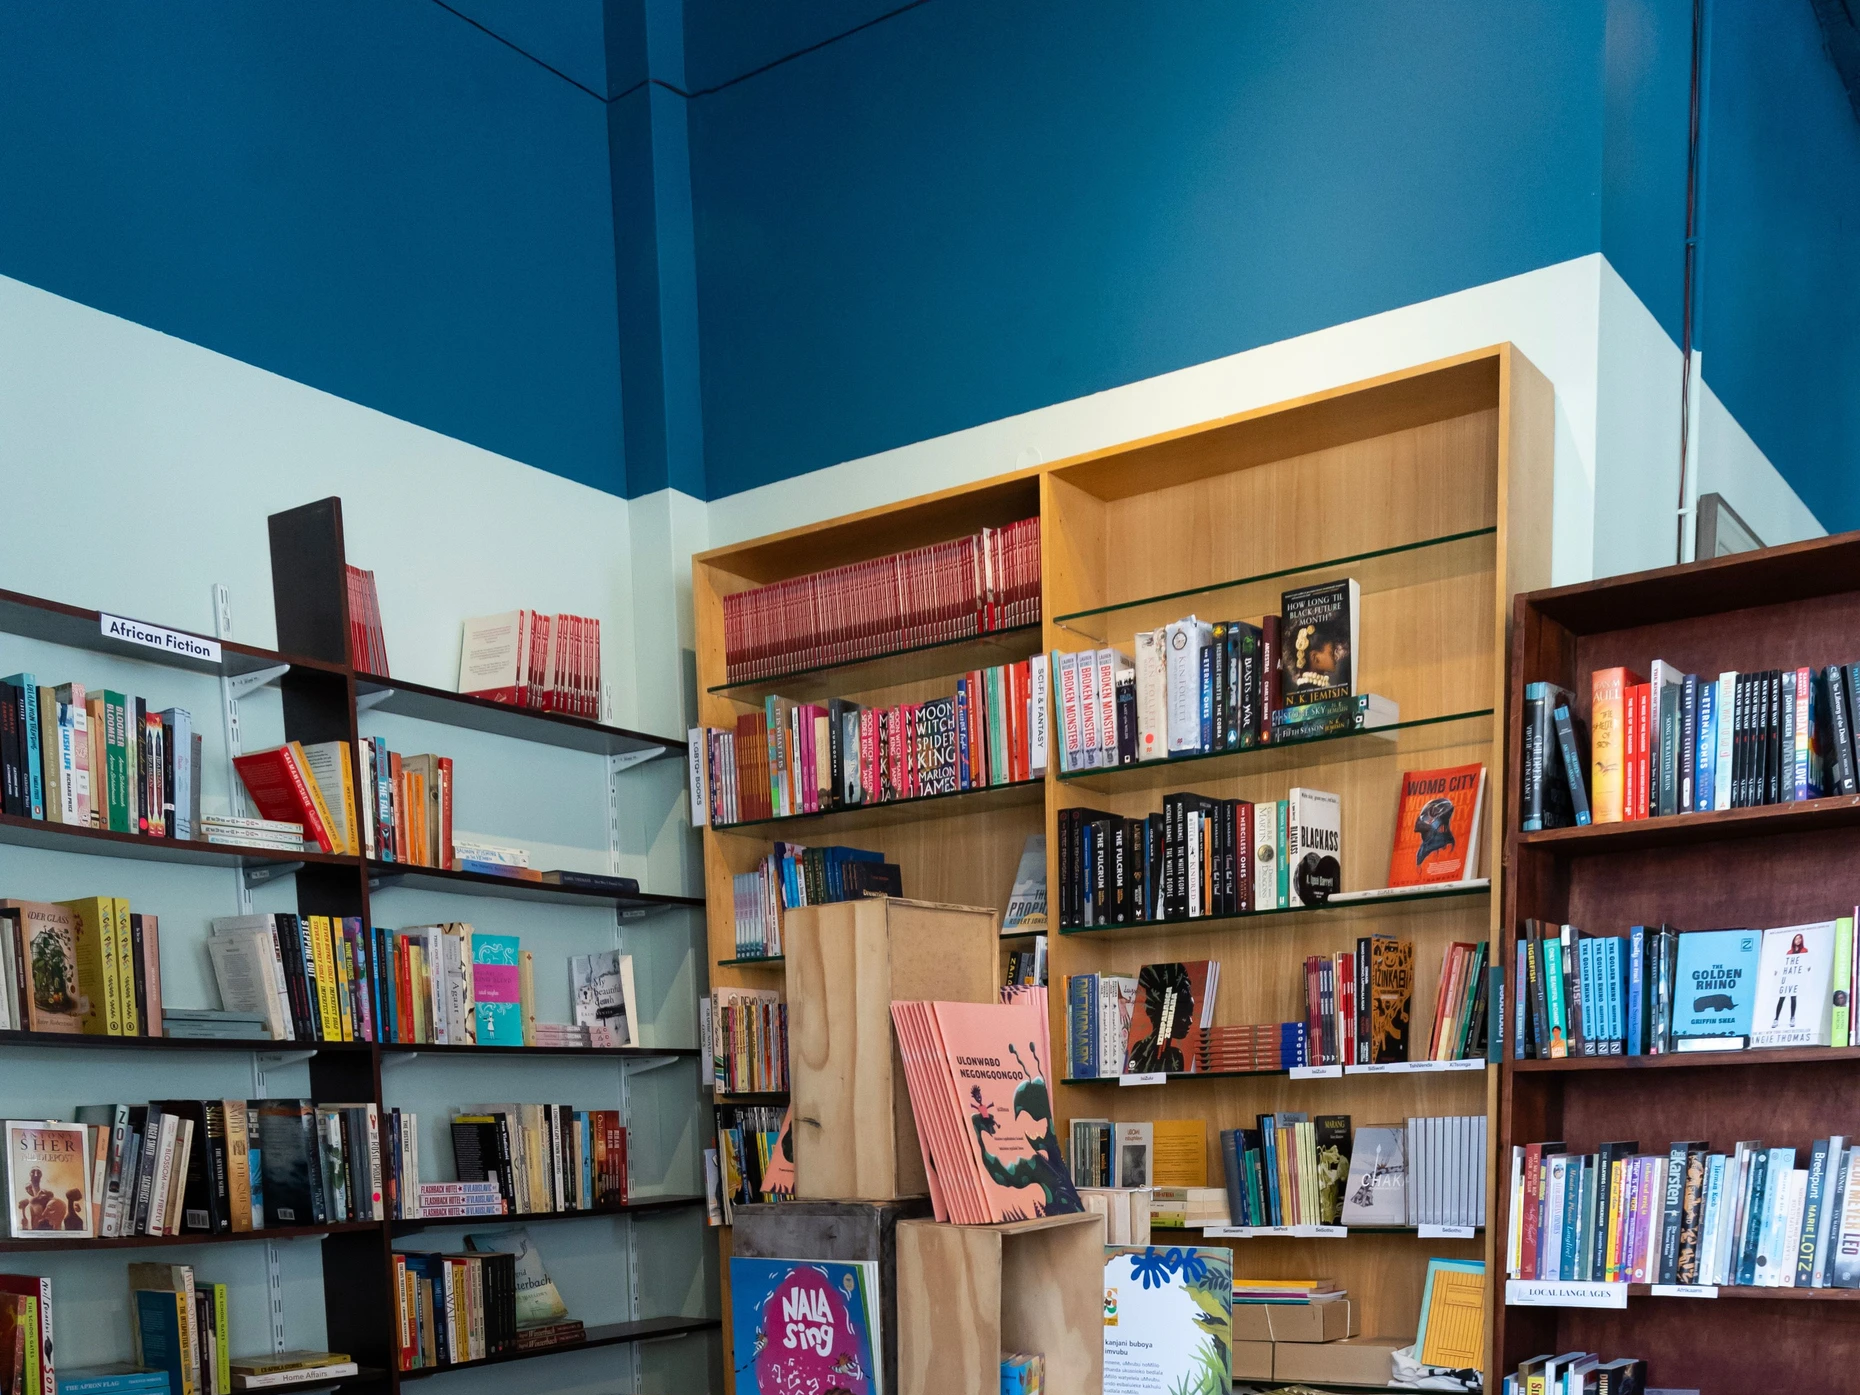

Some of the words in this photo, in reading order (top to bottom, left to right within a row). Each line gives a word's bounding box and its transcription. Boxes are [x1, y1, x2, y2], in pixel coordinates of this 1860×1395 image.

[1287, 602, 1304, 612] HOW
[1308, 597, 1330, 608] LONG
[1290, 609, 1312, 620] BLACK
[1314, 602, 1342, 615] FUTURE
[110, 621, 162, 646] African
[166, 635, 210, 657] Fiction
[1178, 656, 1186, 677] KEN
[1202, 659, 1210, 694] ETERNAL
[1063, 670, 1076, 702] BROKEN
[1082, 668, 1094, 700] BROKEN
[1100, 666, 1112, 698] BROKEN
[1178, 681, 1186, 723] FOLLETT
[1310, 688, 1348, 702] JEMISIN
[1785, 695, 1793, 713] JOHN
[776, 708, 781, 716] IT
[915, 702, 954, 724] MOON
[1701, 698, 1710, 740] ETERNAL
[1796, 700, 1807, 734] FRIDAY
[106, 704, 115, 744] BLOOMER
[116, 706, 124, 747] BLOOMER
[916, 718, 954, 736] WITCH
[1066, 704, 1080, 750] MONSTERS
[1083, 702, 1096, 748] MONSTERS
[1102, 701, 1114, 746] MONSTERS
[1784, 715, 1792, 737] GREEN
[62, 729, 70, 751] LUSH
[917, 732, 955, 751] SPIDER
[1838, 729, 1847, 744] Dead
[64, 753, 72, 770] LIFE
[283, 752, 299, 780] SALMAN
[778, 760, 784, 768] IS
[917, 749, 956, 769] KING
[1700, 744, 1709, 769] ONES
[1796, 751, 1806, 760] IN
[918, 766, 956, 782] MARLON
[1407, 778, 1446, 796] WOMB
[1449, 773, 1477, 792] CITY
[1795, 763, 1806, 786] LOVE
[919, 776, 956, 797] JAMES
[380, 800, 388, 820] FALL
[1096, 832, 1104, 848] THE
[1290, 826, 1298, 855] BLACKASS
[1301, 825, 1339, 852] BLACKASS
[1116, 848, 1124, 886] FULCRUM
[1166, 878, 1174, 898] PEOPLE
[47, 913, 70, 925] GLASS
[1008, 902, 1047, 916] PROPH
[301, 920, 313, 960] STEPPING
[307, 962, 316, 978] OUT
[344, 942, 353, 958] NINE
[346, 960, 354, 980] HOURS
[1528, 943, 1536, 983] TIGERFISH
[1582, 957, 1590, 982] GOLDEN
[1782, 966, 1802, 974] HATE
[1786, 956, 1800, 965] THE
[1692, 969, 1742, 981] GOLDEN
[1696, 979, 1737, 990] RHINO
[1572, 978, 1581, 1006] FUSE
[1779, 985, 1798, 994] GIVE
[1751, 1035, 1774, 1044] ANGIE
[1777, 1033, 1811, 1044] THOMAS
[956, 1056, 1000, 1067] ULONWABO
[960, 1069, 1024, 1080] NEGONGQONGQO
[21, 1131, 74, 1140] ANTONY
[148, 1122, 158, 1139] ROGER
[20, 1138, 76, 1152] SHER
[146, 1139, 156, 1156] SMITH
[216, 1158, 224, 1179] SEVENTH
[1712, 1166, 1722, 1190] Herman
[1809, 1152, 1825, 1199] Breekpunt
[140, 1175, 151, 1203] SACRIFICES
[218, 1180, 226, 1198] SCROLL
[1666, 1156, 1686, 1205] Karsten
[1836, 1167, 1846, 1194] VANNAG
[1710, 1192, 1719, 1207] Koch
[1806, 1205, 1816, 1232] MARIE
[1798, 1234, 1815, 1272] LOTZ
[1842, 1233, 1859, 1255] LEO
[516, 1274, 553, 1292] terbach
[1529, 1288, 1558, 1296] LOCAL
[1560, 1288, 1612, 1298] LANGUAGES
[782, 1286, 834, 1324] NALA
[180, 1316, 188, 1348] INTERPRETERS
[1105, 1340, 1128, 1348] kanjani
[1129, 1341, 1152, 1349] buboya
[44, 1364, 55, 1394] Son
[65, 1384, 79, 1392] THE
[80, 1382, 100, 1390] APRON
[102, 1380, 120, 1388] FLAG
[283, 1374, 304, 1382] Home
[306, 1371, 328, 1380] Affairs
